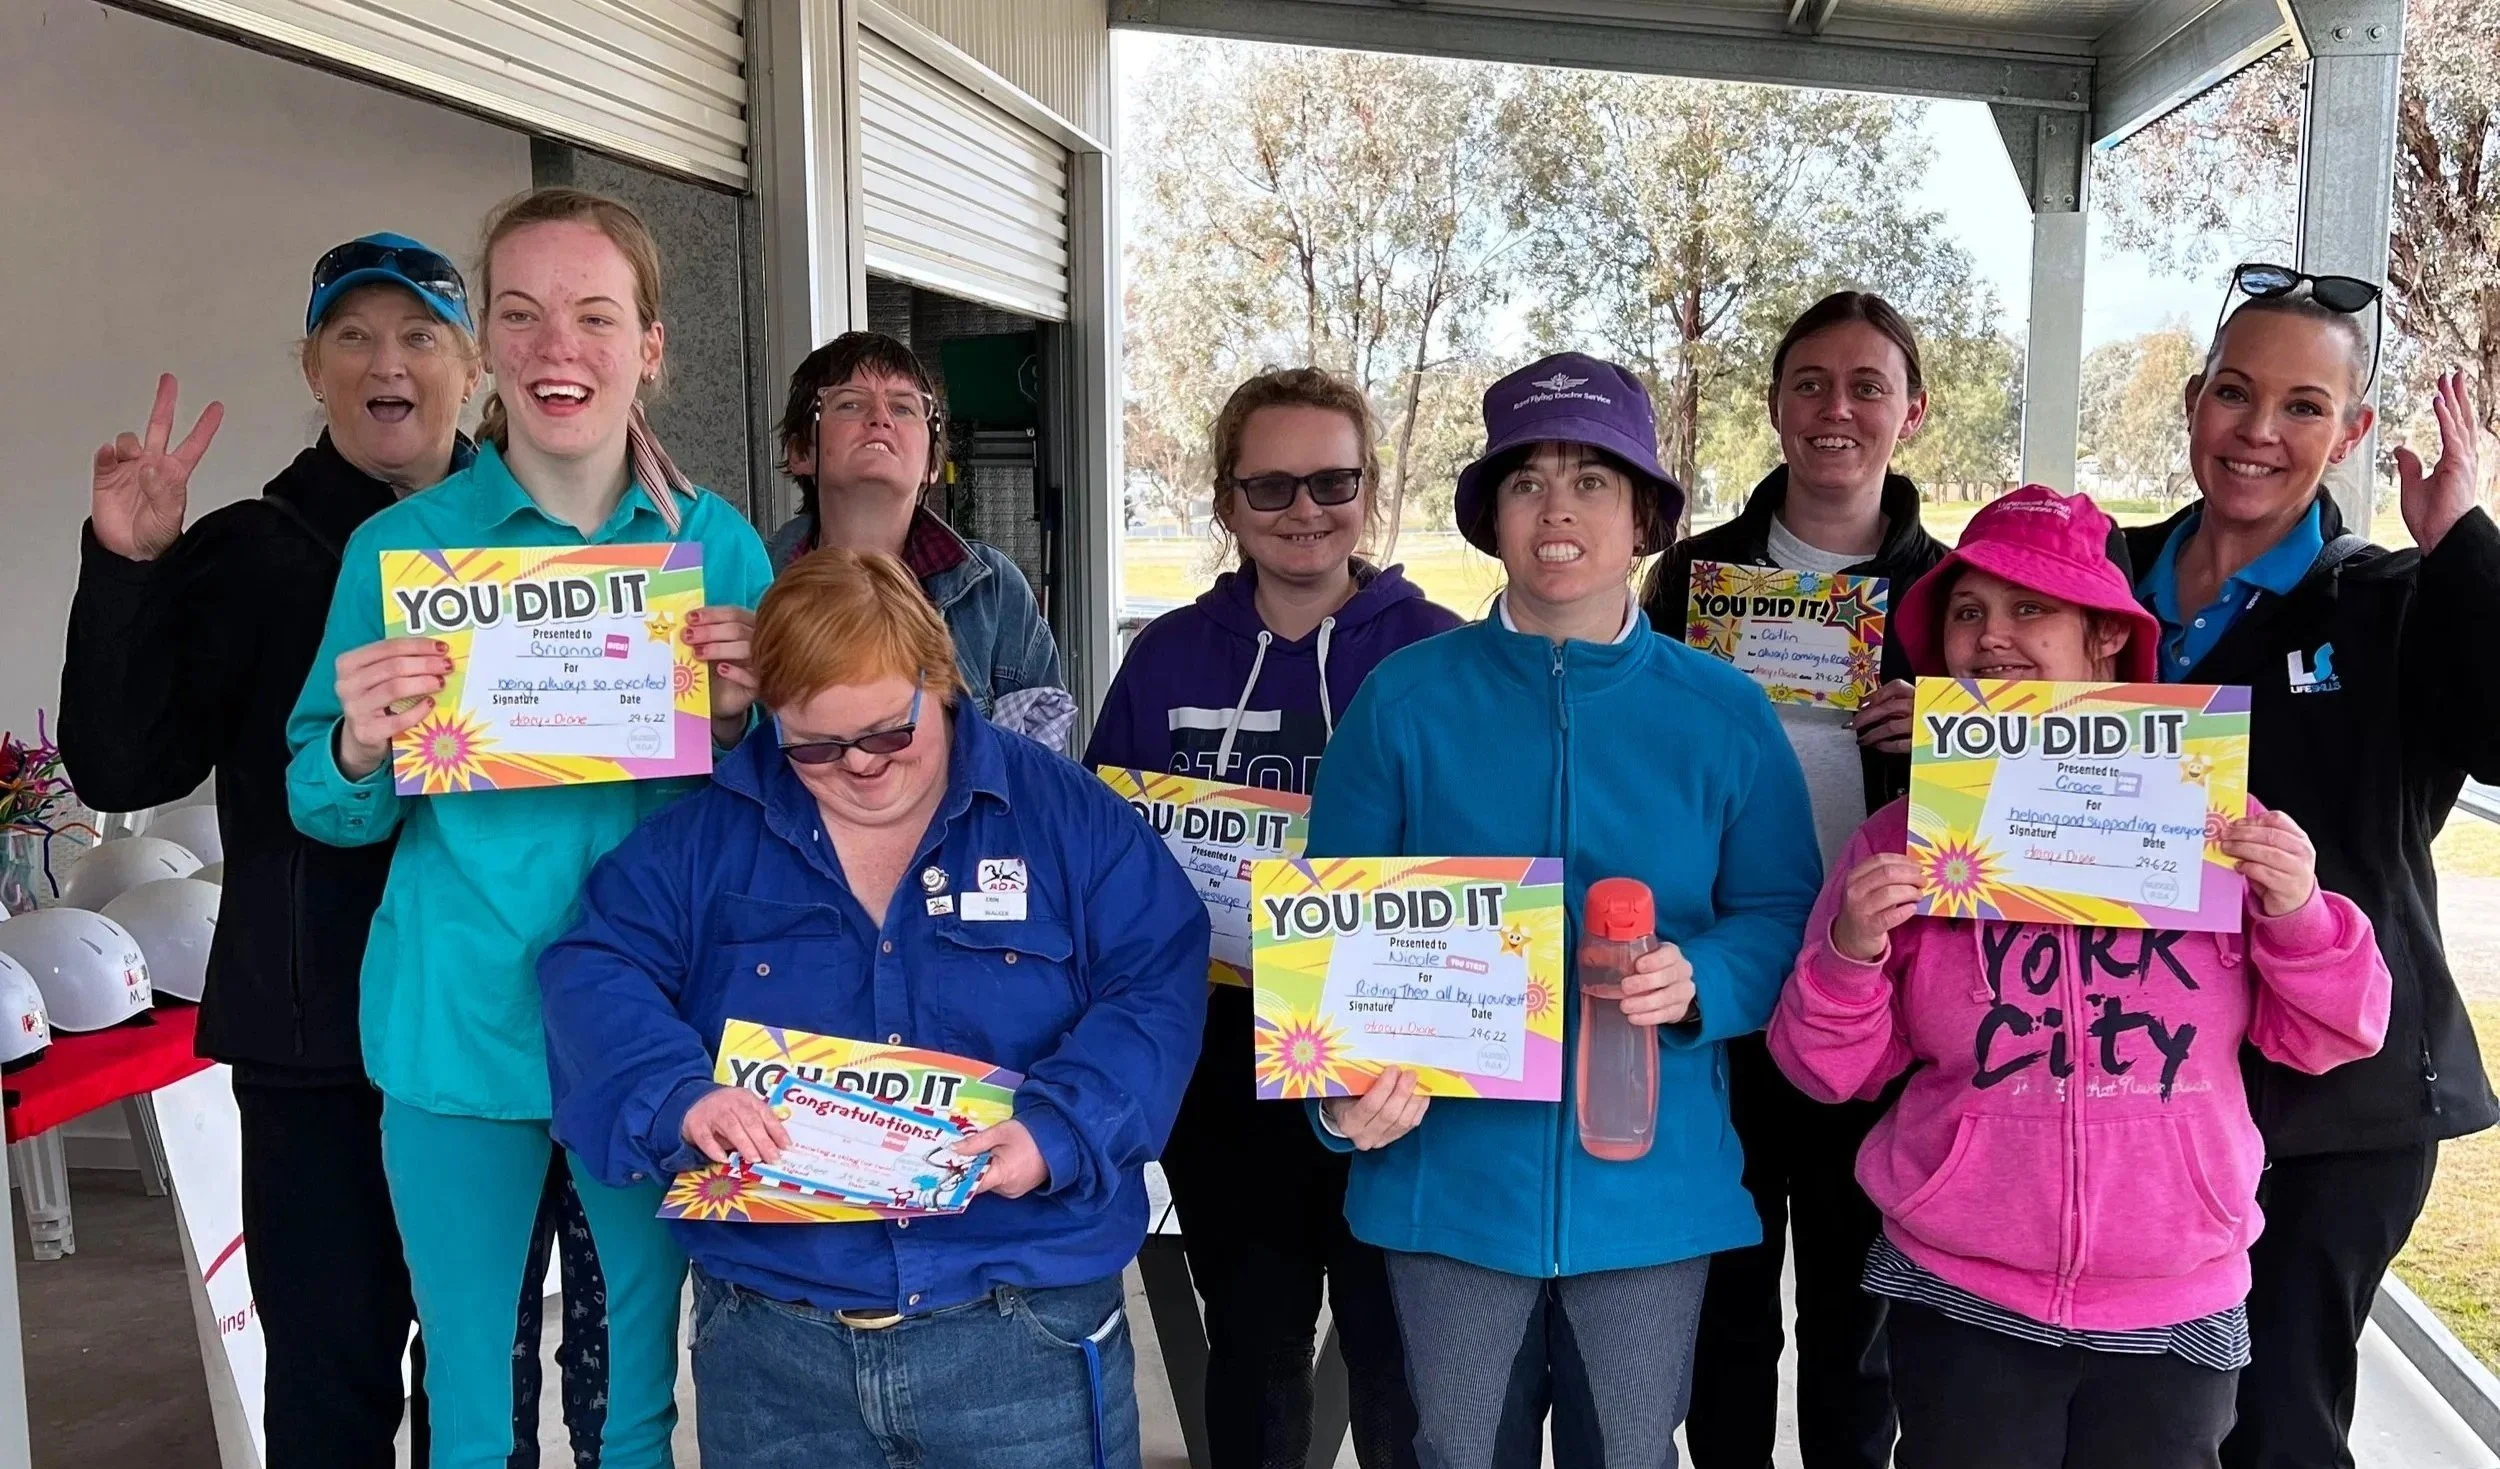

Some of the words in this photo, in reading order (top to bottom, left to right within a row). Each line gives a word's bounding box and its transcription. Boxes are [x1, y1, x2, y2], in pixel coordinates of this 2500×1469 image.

[397, 585, 498, 629] YOU
[515, 579, 595, 622] DID
[610, 573, 646, 614] IT
[1692, 594, 1746, 617] YOU
[1752, 597, 1795, 617] DID
[1796, 600, 1831, 623] IT!
[533, 629, 581, 639] Presented
[583, 630, 592, 639] to
[1762, 628, 1798, 643] Caitlin
[530, 641, 602, 656] Brianna
[1792, 652, 1820, 667] coming
[1821, 653, 1830, 663] to
[564, 663, 578, 673] For
[497, 677, 533, 697] being
[538, 676, 586, 693] always
[593, 679, 606, 689] so
[614, 674, 666, 689] excited
[493, 694, 539, 705] Signature
[620, 695, 641, 704] Date
[1927, 715, 2027, 755] YOU
[2044, 715, 2128, 755] DID
[2144, 714, 2183, 754] IT
[2057, 763, 2107, 777] Presented
[2056, 775, 2104, 794] Grace
[2086, 799, 2102, 810] For
[1183, 809, 1246, 843] DID
[1257, 815, 1289, 849] IT
[2009, 807, 2059, 829] helping
[2063, 813, 2084, 826] and
[2087, 815, 2156, 839] supporting
[2009, 824, 2057, 839] Signature
[2143, 838, 2165, 849] Date
[1191, 846, 1228, 861] Presented
[1229, 853, 1237, 862] to
[1209, 878, 1221, 888] For
[1265, 893, 1359, 936] YOU
[1375, 890, 1452, 930] DID
[1467, 887, 1503, 926] IT
[1390, 937, 1436, 949] Presented
[1438, 940, 1447, 950] to
[1389, 951, 1440, 966] Nicole
[1418, 973, 1432, 983] For
[1356, 979, 1397, 1003] Riding
[1436, 985, 1453, 1000] all
[1458, 988, 1472, 1007] by
[1478, 992, 1529, 1010] yourself
[1350, 1002, 1393, 1012] Signature
[1471, 1009, 1492, 1019] Date
[837, 1070, 909, 1102] DID
[921, 1075, 962, 1107] IT
[784, 1088, 943, 1142] Congratulations!
